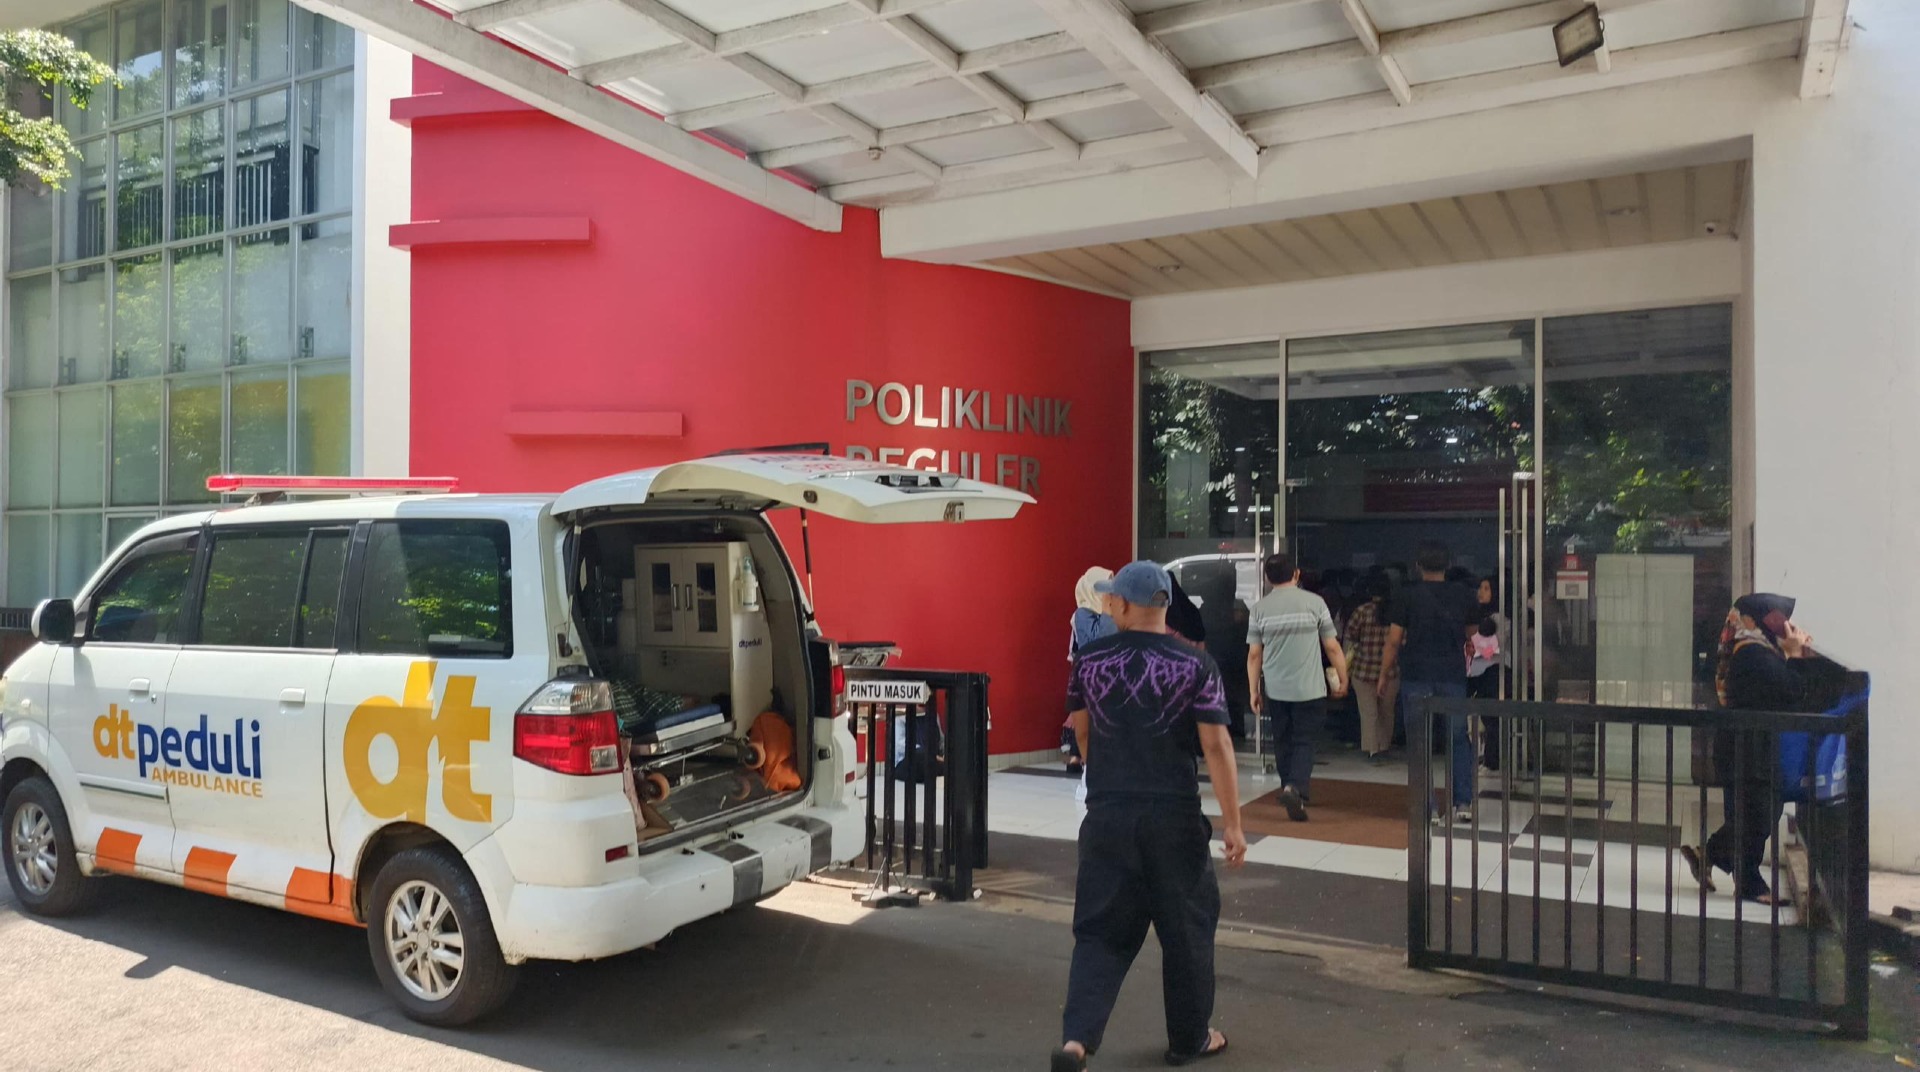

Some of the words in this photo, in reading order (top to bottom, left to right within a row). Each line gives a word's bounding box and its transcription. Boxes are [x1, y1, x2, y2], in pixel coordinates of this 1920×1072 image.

[846, 379, 1073, 438] POLIKLINIK
[851, 684, 881, 698] PINTU
[885, 685, 921, 699] MASUK
[343, 660, 492, 826] dt
[152, 767, 263, 798] AMBULANCE
